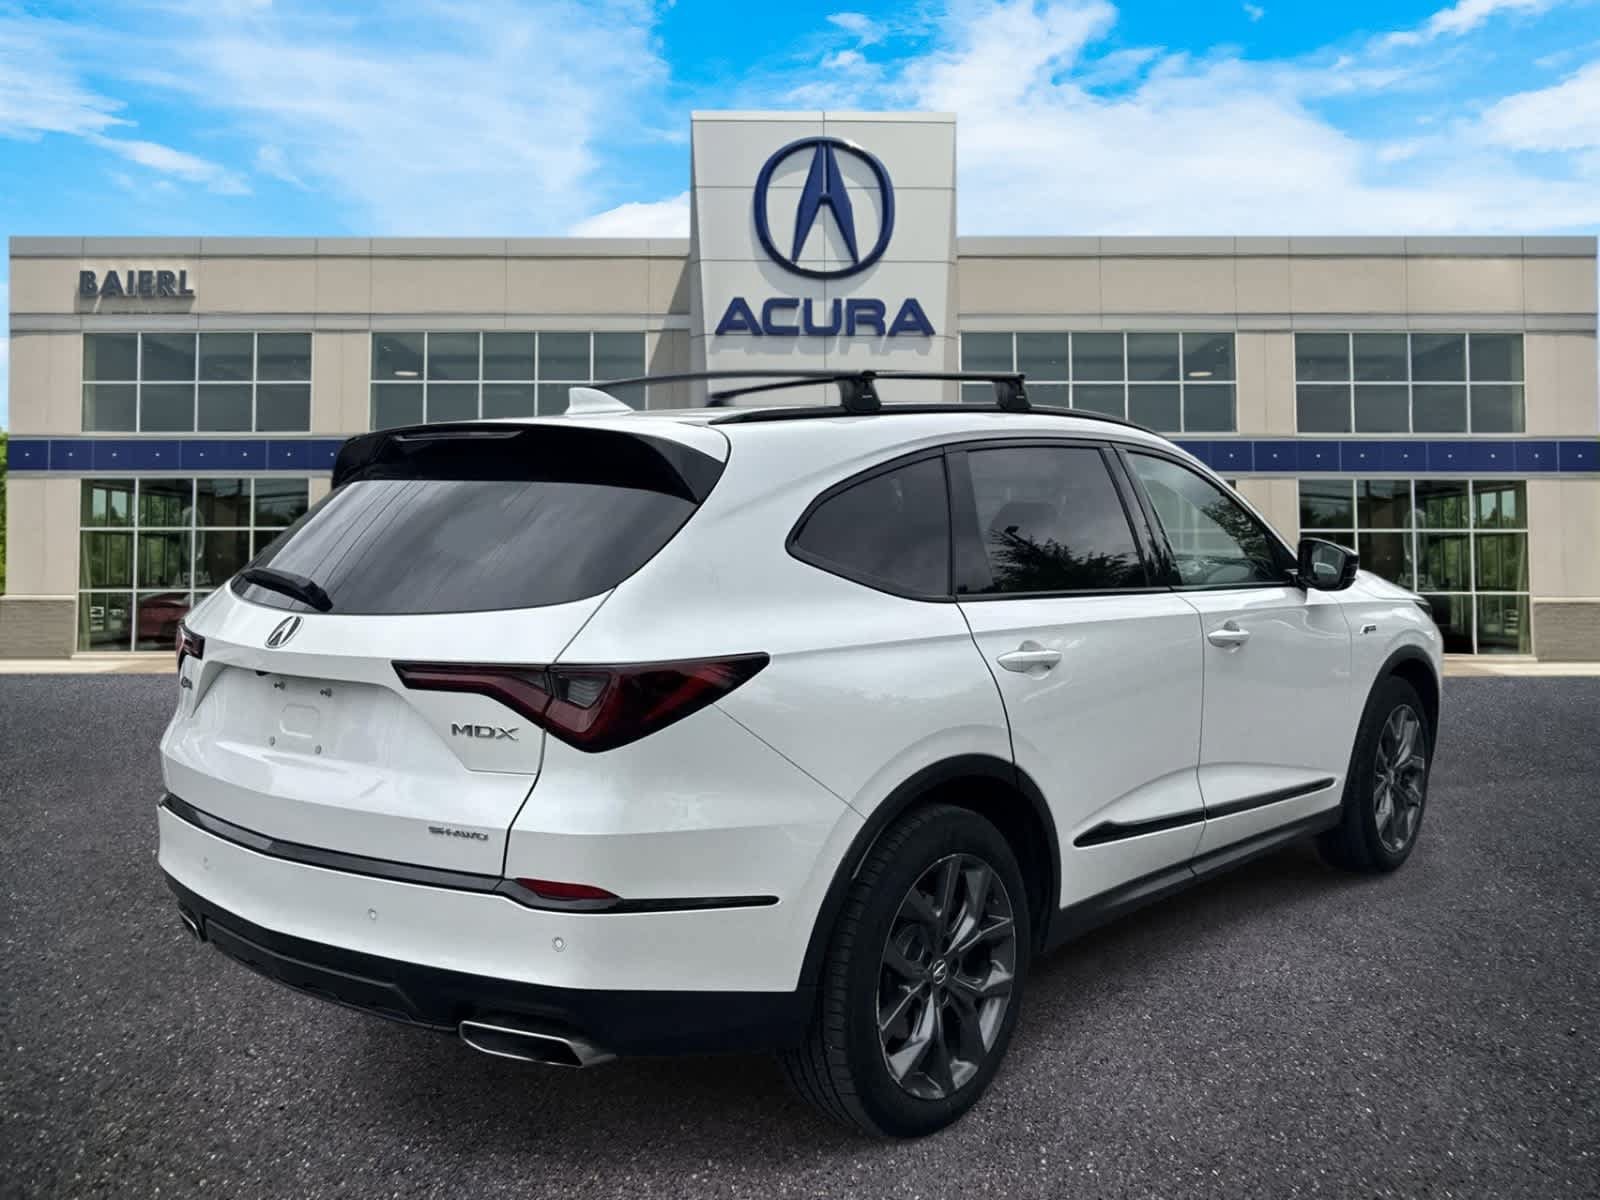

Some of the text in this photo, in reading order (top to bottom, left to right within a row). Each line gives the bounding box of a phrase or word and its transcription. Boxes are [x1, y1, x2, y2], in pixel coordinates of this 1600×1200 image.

[79, 269, 194, 296] BAIERL
[714, 297, 936, 337] ACURA
[451, 723, 520, 742] MDX
